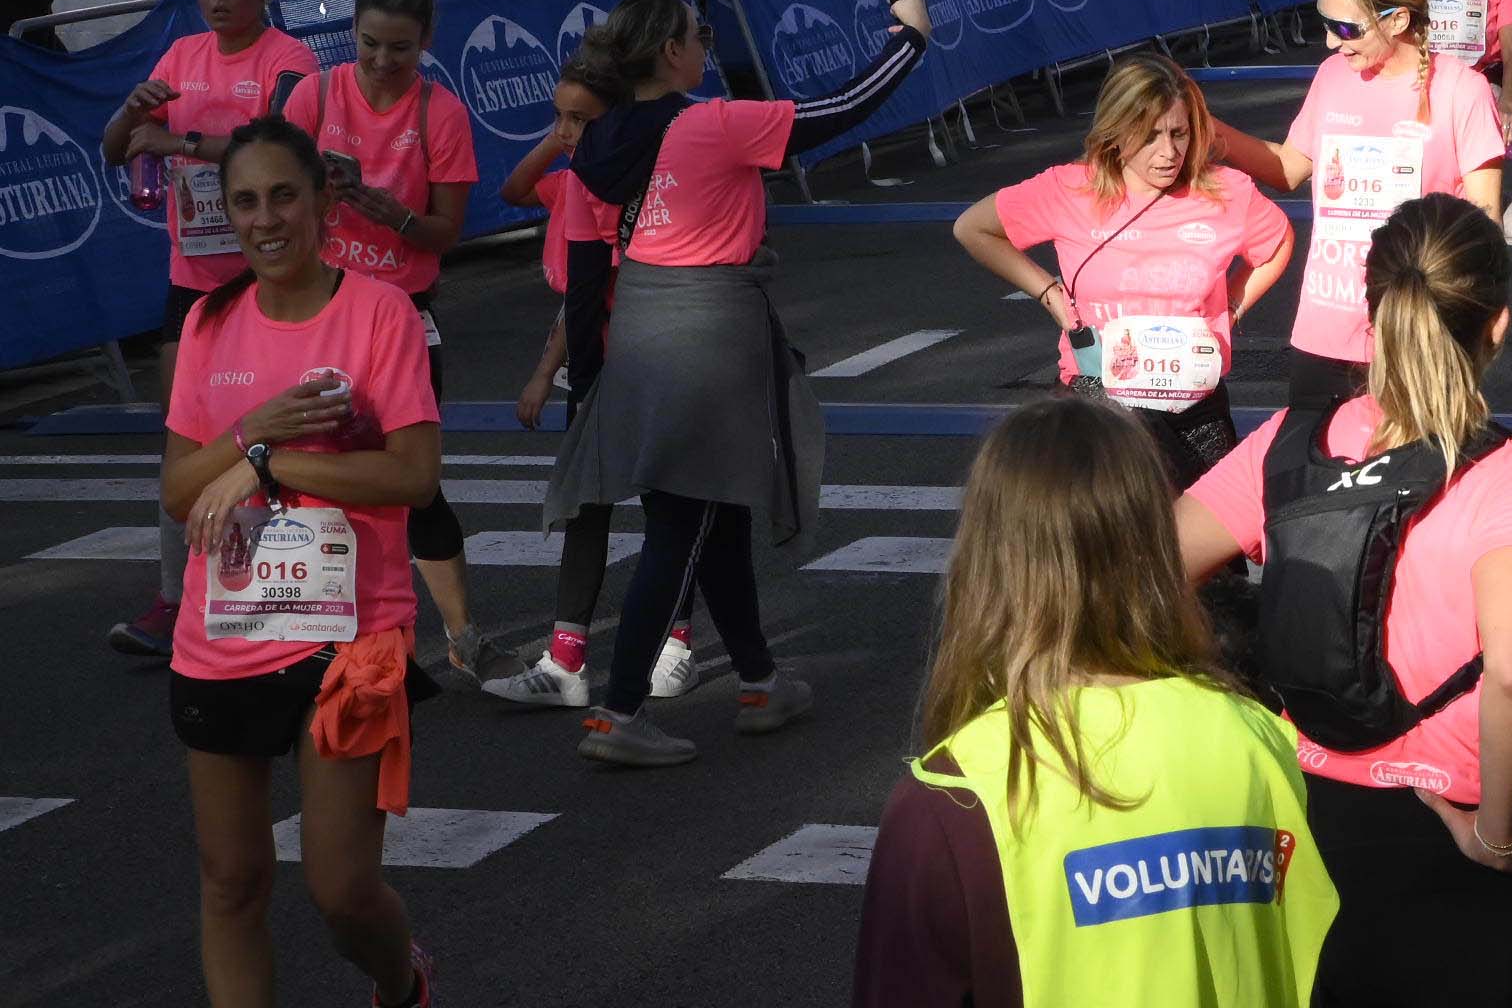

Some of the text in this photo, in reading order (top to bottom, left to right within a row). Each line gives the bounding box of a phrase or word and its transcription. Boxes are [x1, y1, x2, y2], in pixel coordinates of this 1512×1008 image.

[1430, 20, 1458, 31] 016
[1348, 177, 1383, 193] 016
[637, 208, 673, 229] UJER
[1143, 358, 1181, 374] 016
[210, 371, 255, 387] OYSHO
[1149, 377, 1173, 387] 1231
[1116, 389, 1146, 397] CARRERA
[1168, 391, 1191, 399] MUJER
[320, 526, 347, 534] SUMA
[257, 561, 308, 580] 016
[261, 587, 302, 599] 30398
[300, 622, 347, 633] Santander
[1375, 766, 1444, 791] ASTURIANA
